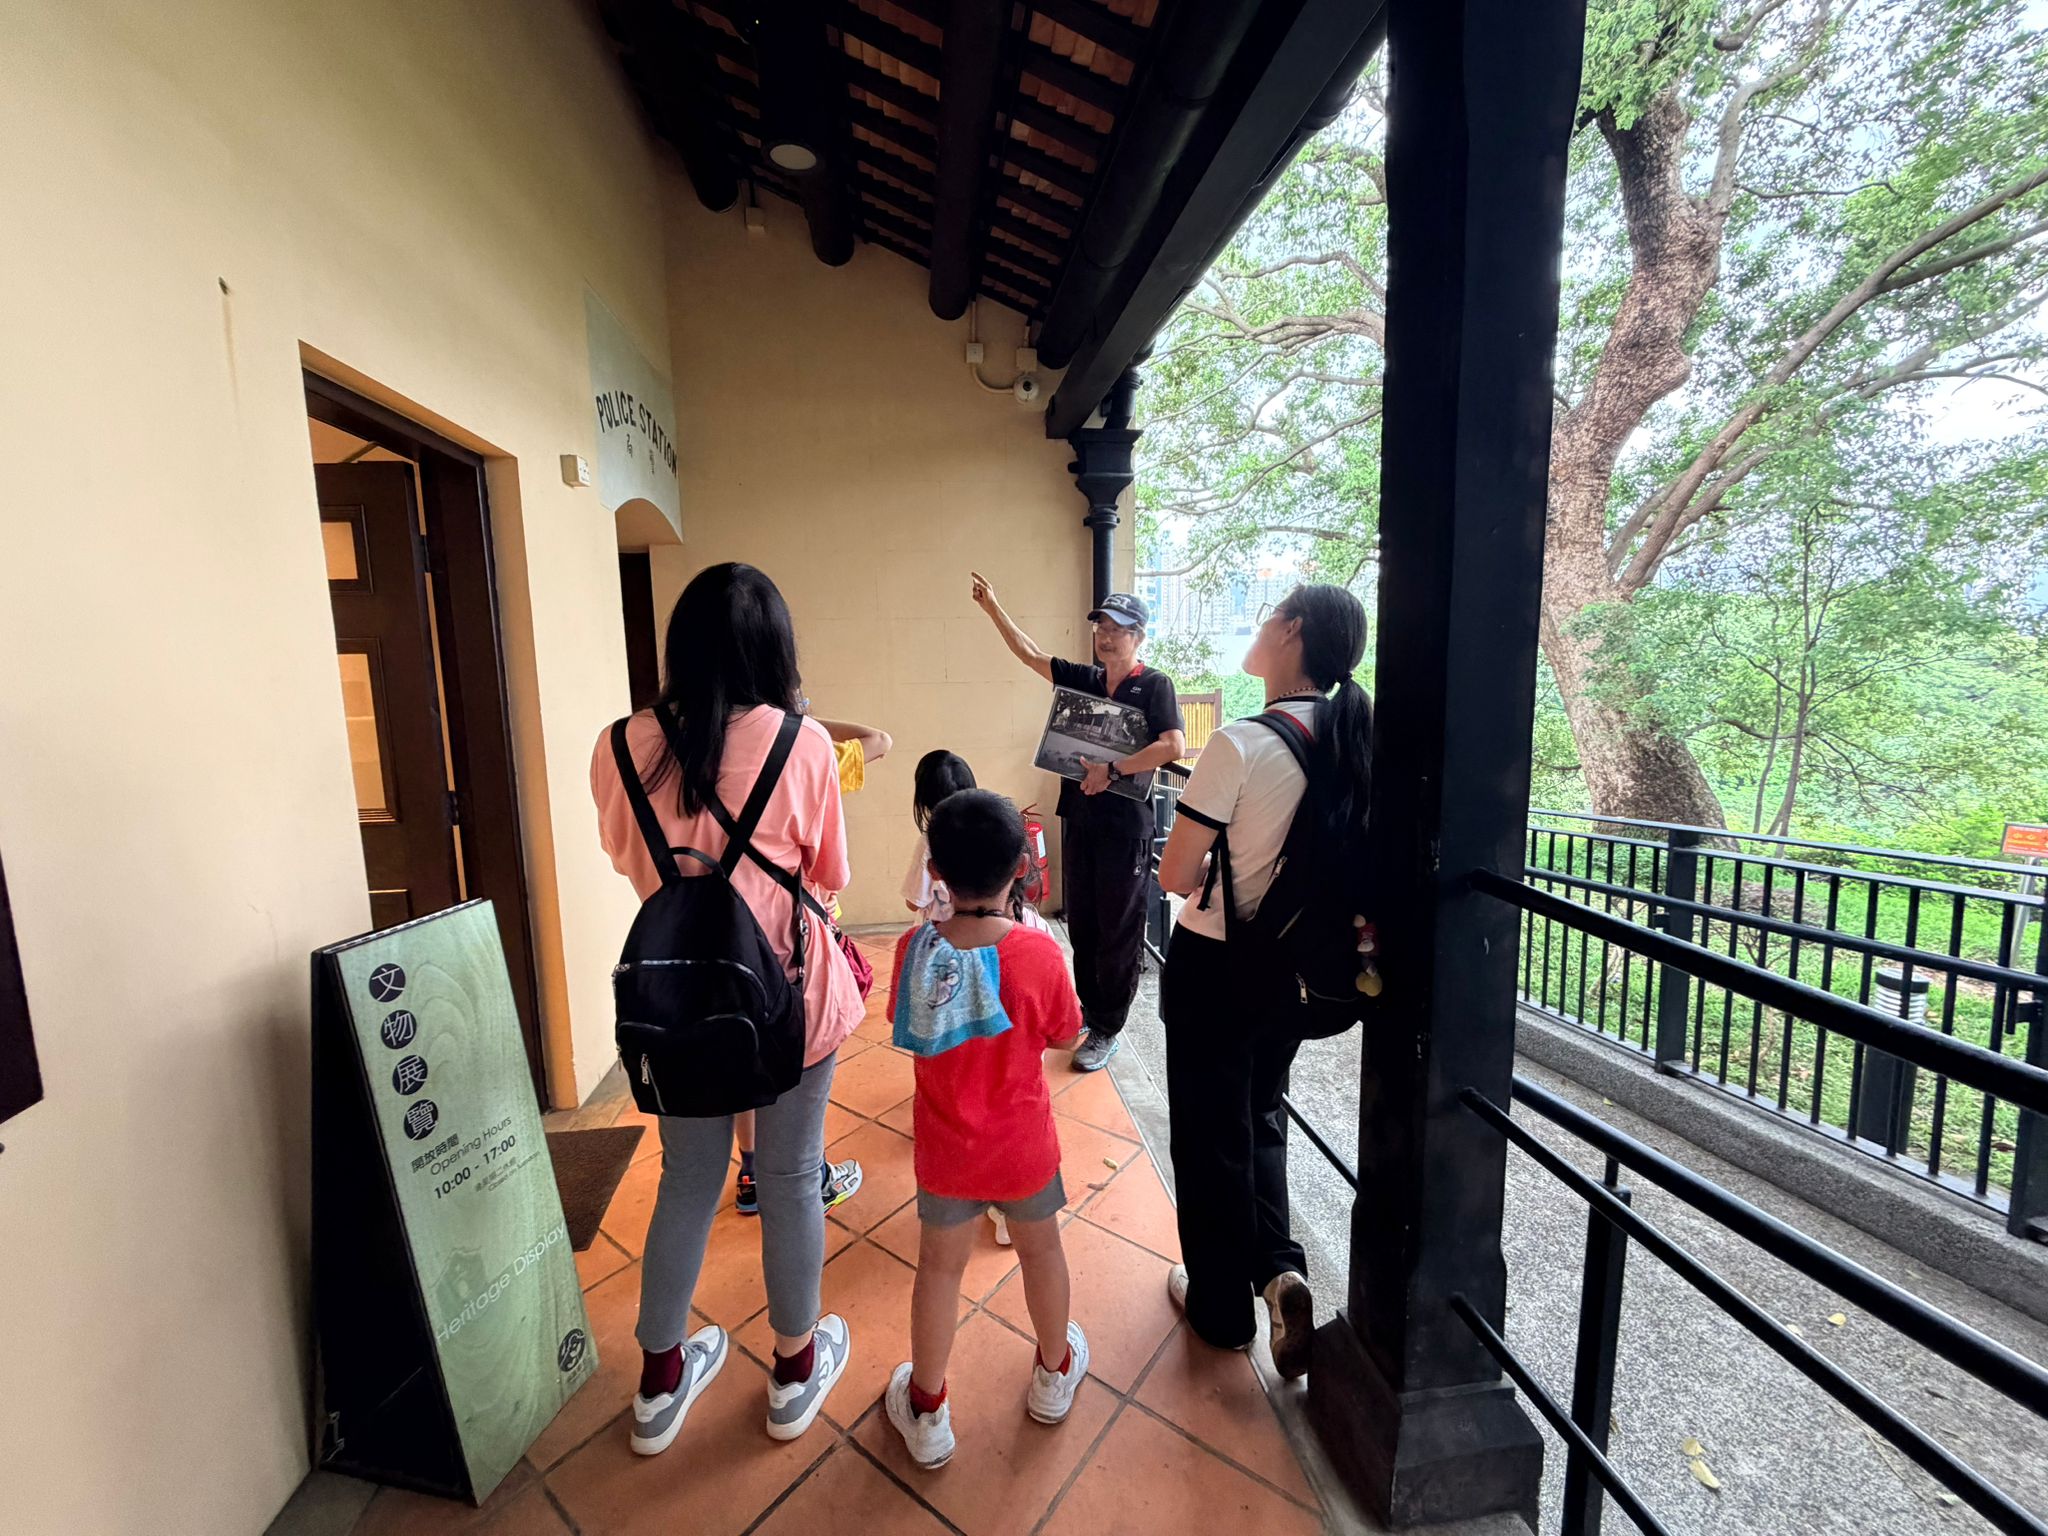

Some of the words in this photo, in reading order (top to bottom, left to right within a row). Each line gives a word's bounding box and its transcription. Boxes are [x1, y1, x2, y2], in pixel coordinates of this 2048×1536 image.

[596, 390, 637, 433] POLICE
[638, 403, 678, 478] STATION
[370, 964, 439, 1141] 文物展覽
[411, 1133, 459, 1173] 開放時間
[430, 1137, 482, 1175] Opening
[482, 1117, 512, 1140] Hours
[434, 1167, 471, 1199] 10:00
[483, 1135, 516, 1164] 17:00
[435, 1273, 511, 1346] Heritage
[513, 1222, 566, 1276] Display
